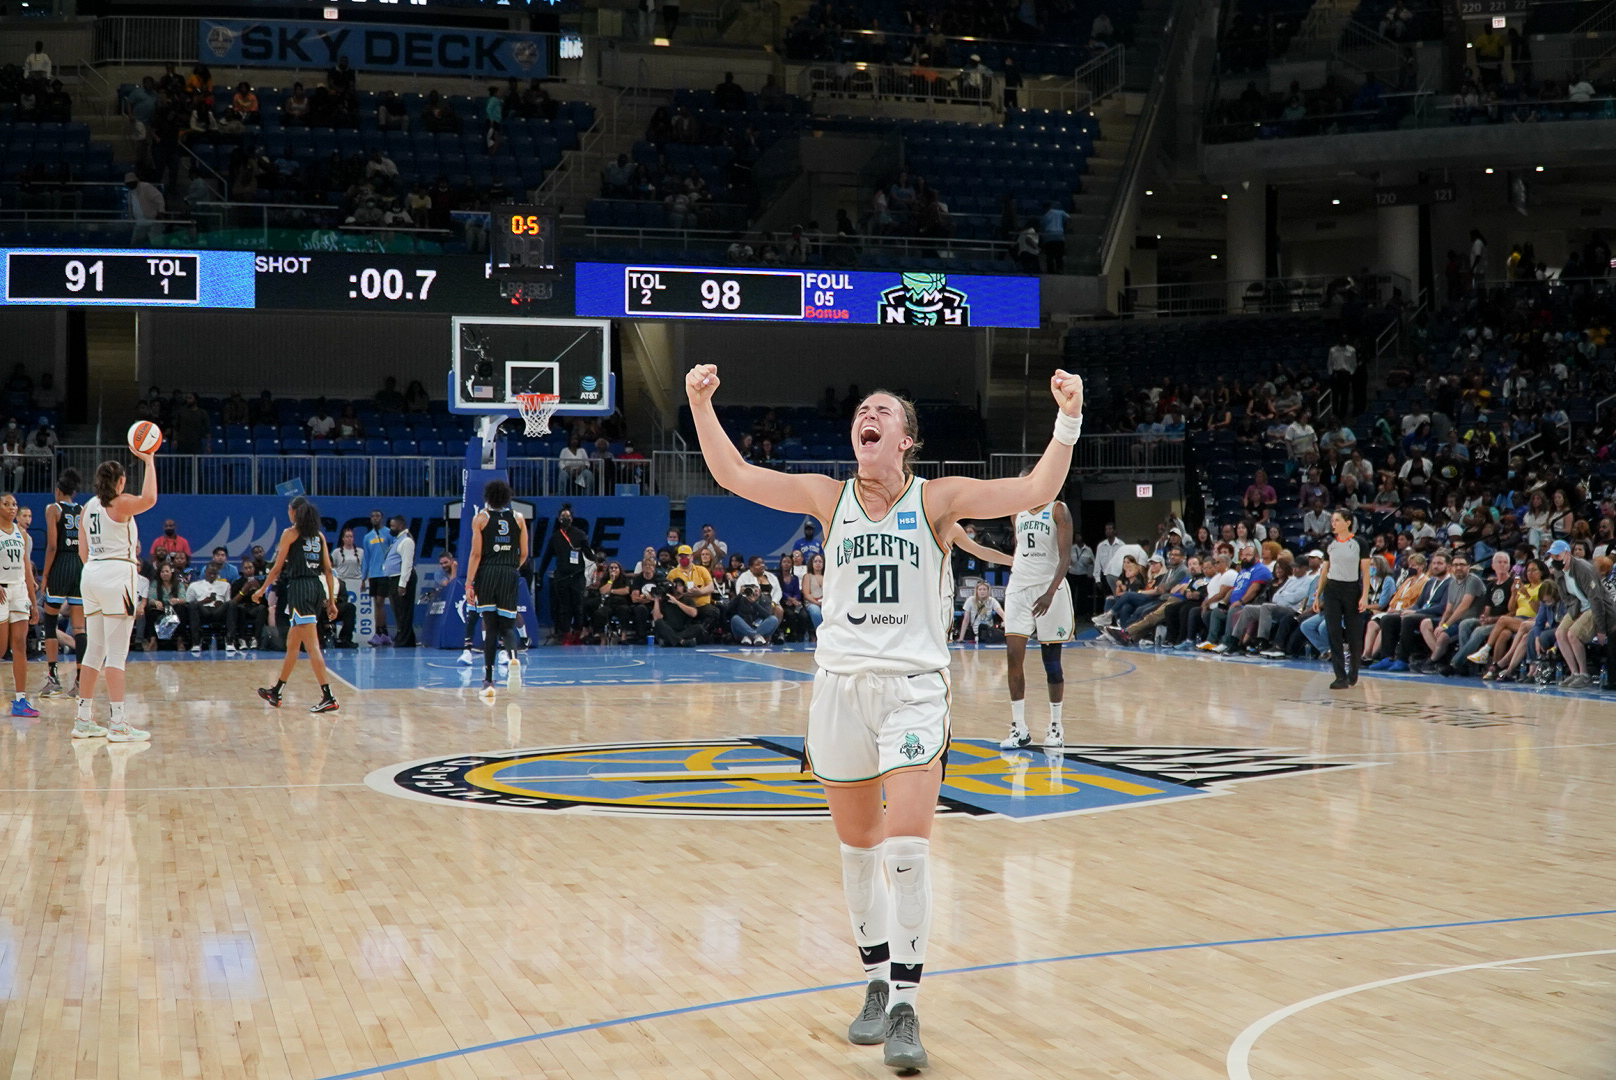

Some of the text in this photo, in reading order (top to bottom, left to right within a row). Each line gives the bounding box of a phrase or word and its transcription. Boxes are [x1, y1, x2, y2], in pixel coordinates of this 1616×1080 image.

[1462, 3, 1482, 13] 220
[1489, 2, 1506, 11] 221
[241, 25, 507, 72] SKY DECK
[1376, 190, 1452, 205] 120 121
[255, 257, 311, 275] SHOT
[64, 258, 186, 292] 91 TOL
[629, 273, 666, 290] TOL
[806, 273, 853, 290] FOUL
[161, 279, 169, 294] 1
[348, 269, 437, 300] :00.7
[641, 290, 652, 304] 2
[701, 279, 741, 310] 98
[814, 291, 834, 306] 05
[805, 306, 849, 320] Bonus
[885, 307, 905, 324] N
[580, 392, 599, 400] AT&T
[89, 513, 101, 535] 31
[497, 519, 510, 536] 3
[899, 517, 916, 525] HSS
[302, 536, 321, 553] 35
[1027, 532, 1036, 549] 6
[7, 549, 20, 562] 44
[857, 564, 900, 604] 20
[360, 618, 373, 636] GO
[411, 759, 549, 806] CHICAGO
